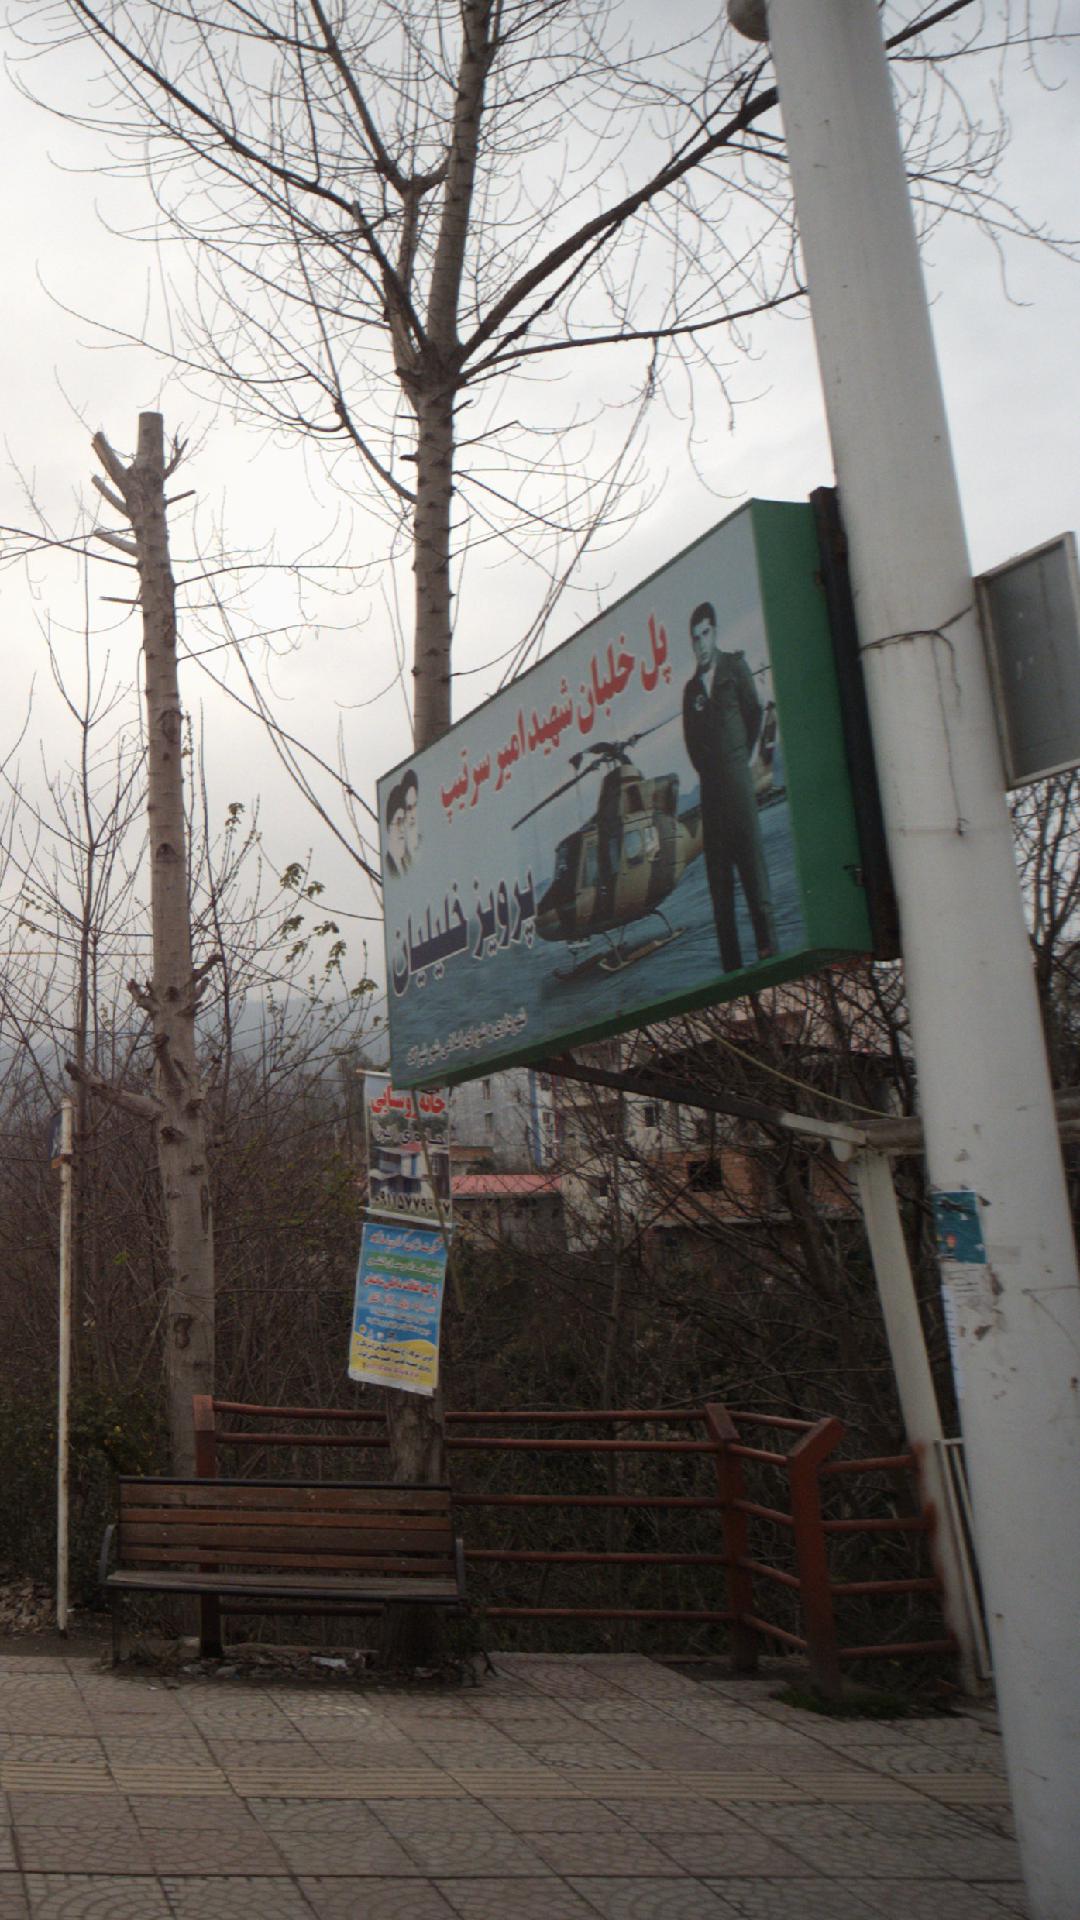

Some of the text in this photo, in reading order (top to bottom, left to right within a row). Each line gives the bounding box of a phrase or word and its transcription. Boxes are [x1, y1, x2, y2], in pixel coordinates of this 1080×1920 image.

[441, 613, 672, 824] پل خلبان شهید امیر سرتیپ
[392, 864, 538, 997] پرویز خلیلیان
